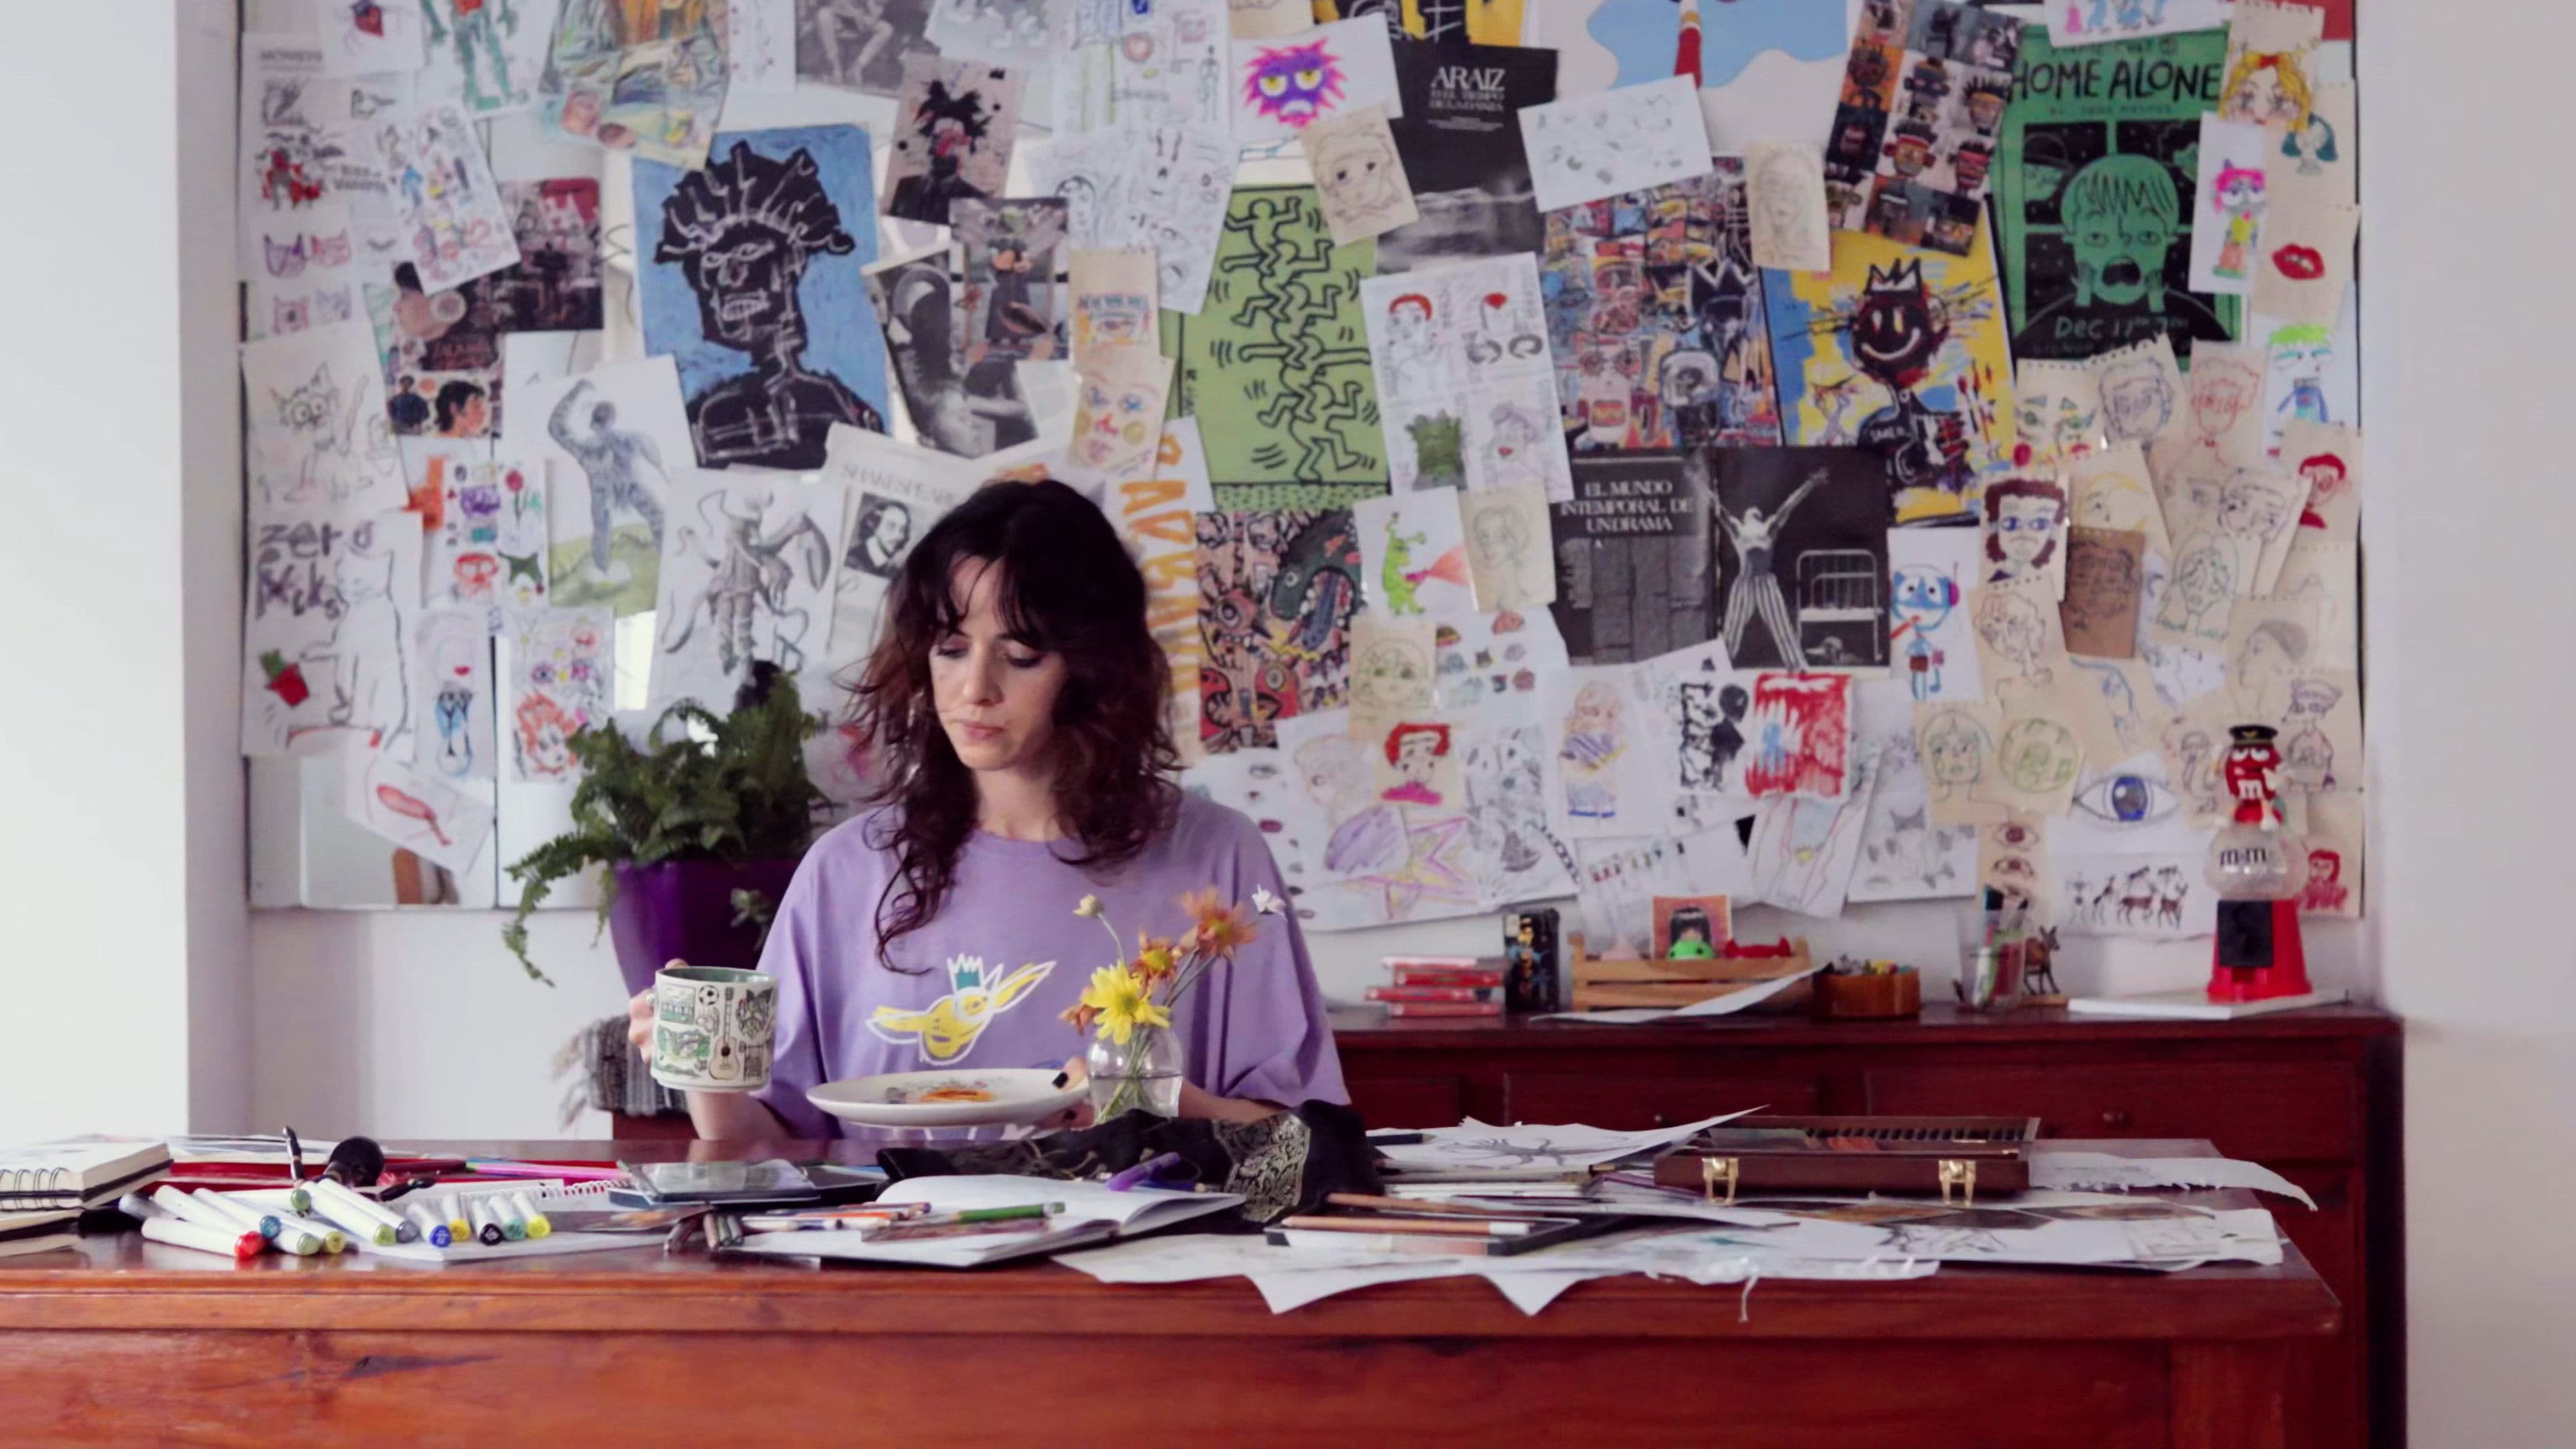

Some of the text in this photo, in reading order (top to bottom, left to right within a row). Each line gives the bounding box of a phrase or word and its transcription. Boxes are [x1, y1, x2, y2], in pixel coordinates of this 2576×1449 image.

[1430, 65, 1505, 91] ARAIZ
[2008, 58, 2223, 104] HOME ALONE
[1609, 480, 1674, 496] MUNDO
